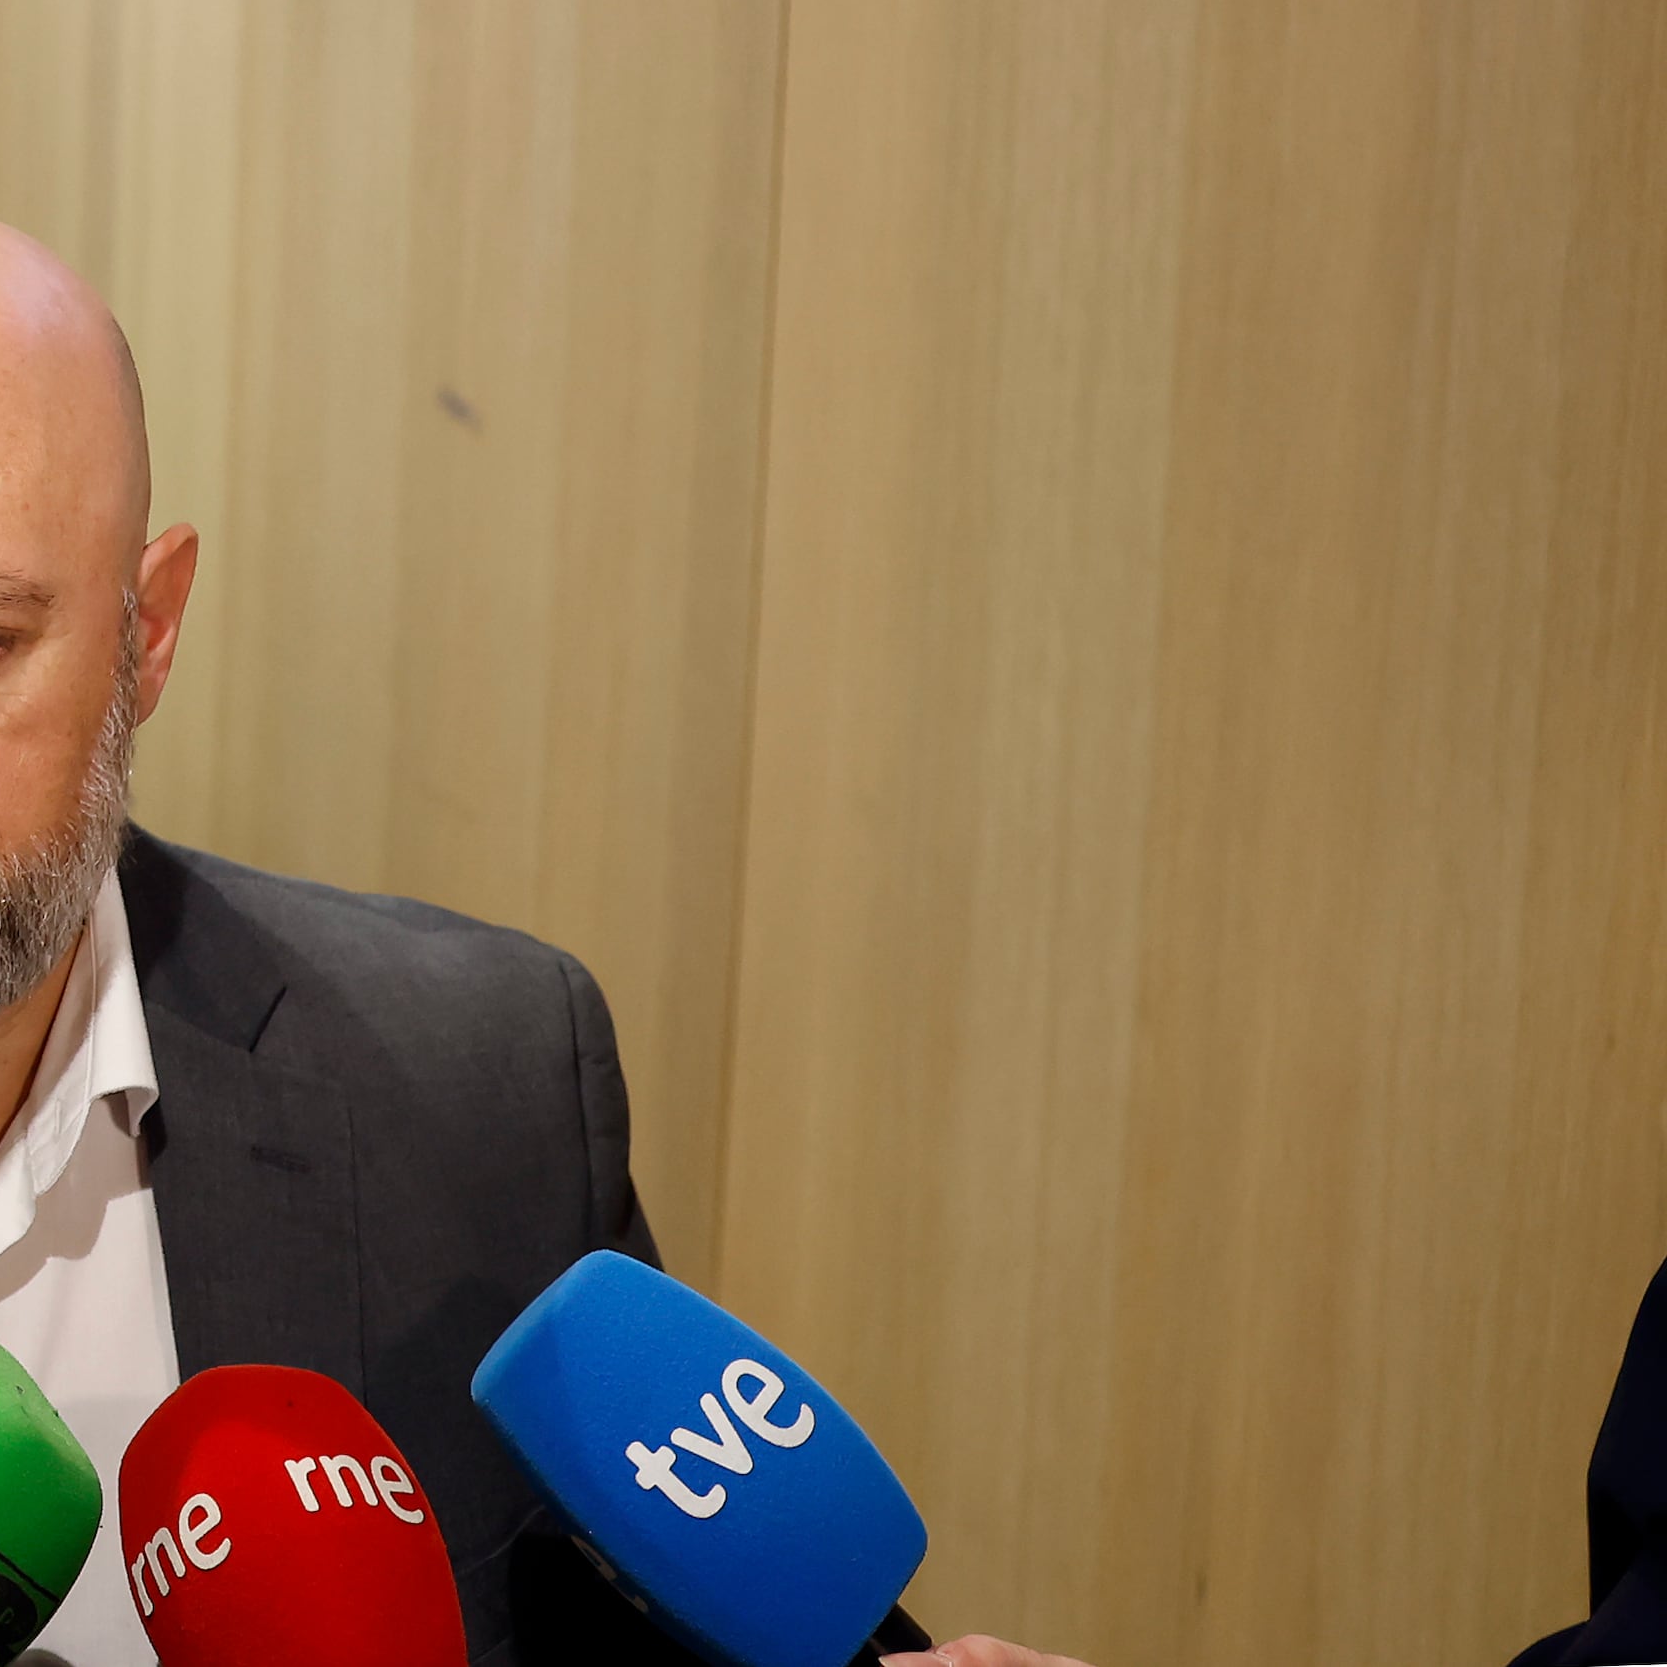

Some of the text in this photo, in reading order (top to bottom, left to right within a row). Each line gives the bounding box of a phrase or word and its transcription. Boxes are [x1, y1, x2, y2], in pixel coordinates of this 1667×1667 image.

[283, 1452, 426, 1525] rne
[624, 1357, 817, 1520] tve
[131, 1491, 232, 1617] rne
